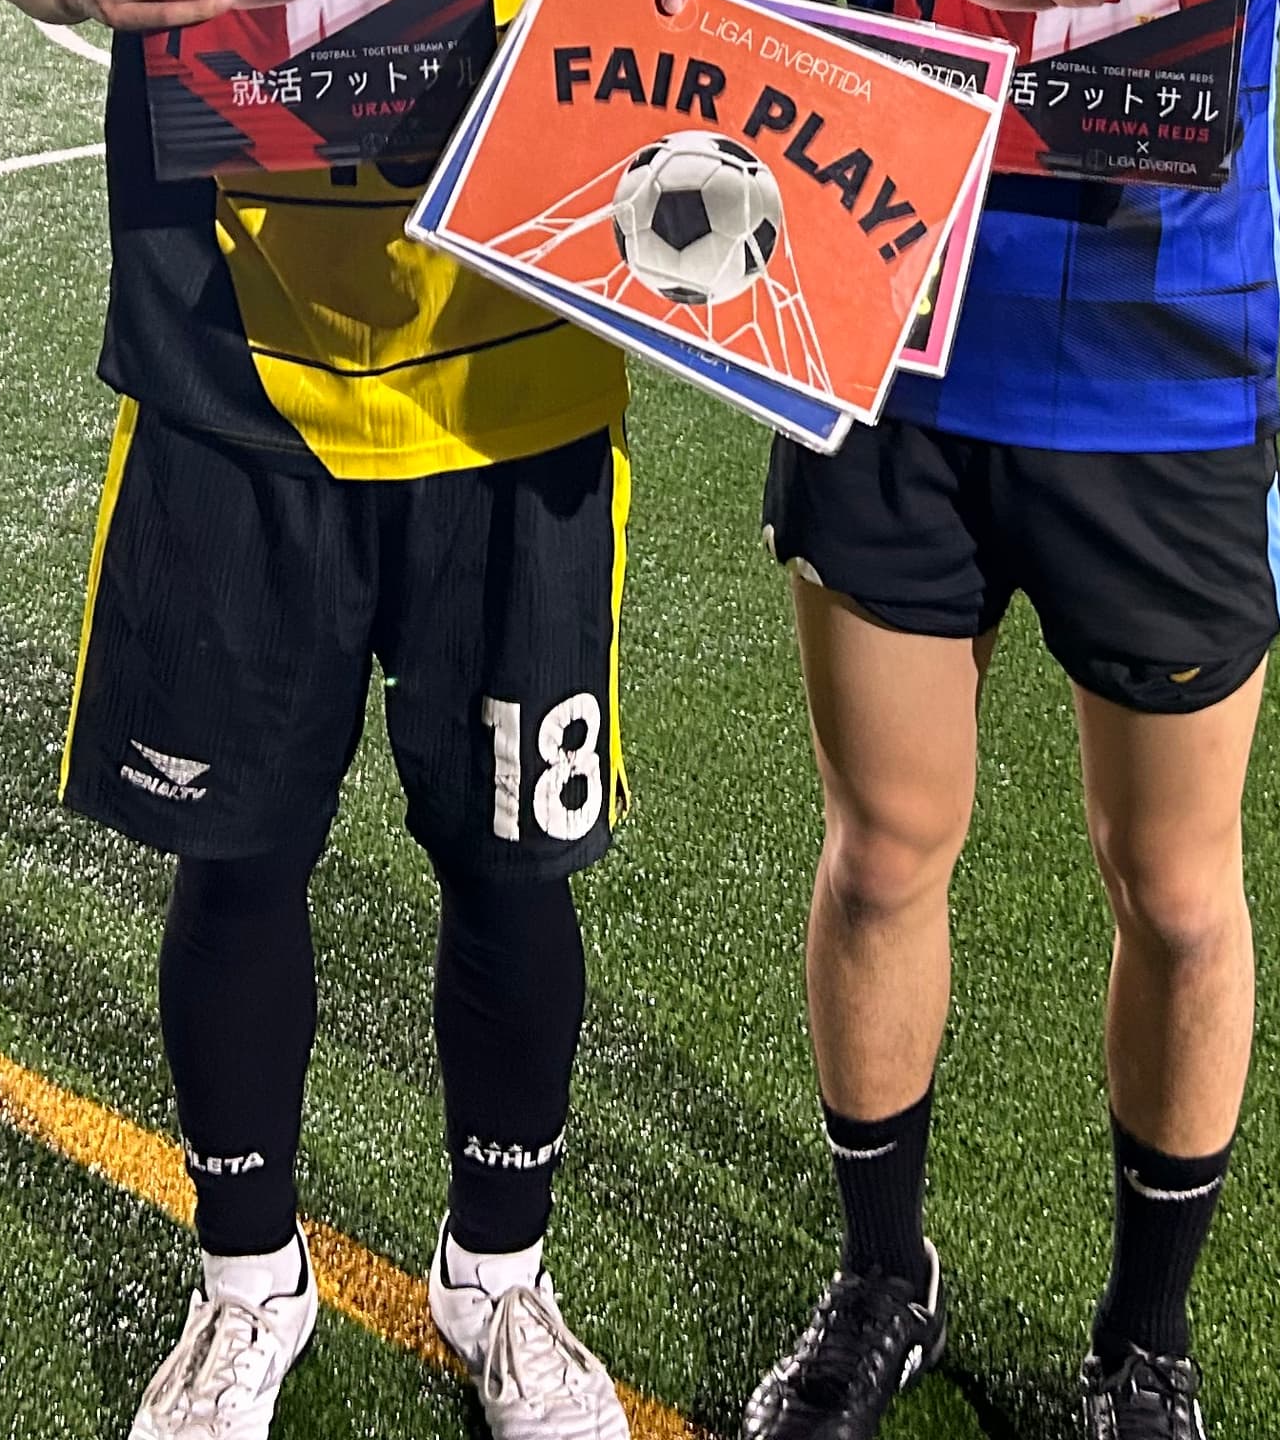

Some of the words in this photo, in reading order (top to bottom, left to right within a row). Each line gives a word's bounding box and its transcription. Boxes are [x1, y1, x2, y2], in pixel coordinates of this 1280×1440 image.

[311, 49, 357, 61] FOOTBALL
[362, 45, 410, 57] TOGETHER
[1051, 61, 1097, 74] FOOTBALL
[1103, 66, 1150, 79] TOGETHER
[1155, 71, 1185, 81] URAWA
[1189, 72, 1214, 84] REDS
[1082, 117, 1149, 137] URAWA
[1157, 123, 1210, 144] REDS
[552, 45, 727, 122] FAIR
[742, 84, 929, 264] PLAY!
[121, 764, 207, 800] PENALTY
[481, 692, 603, 842] 18
